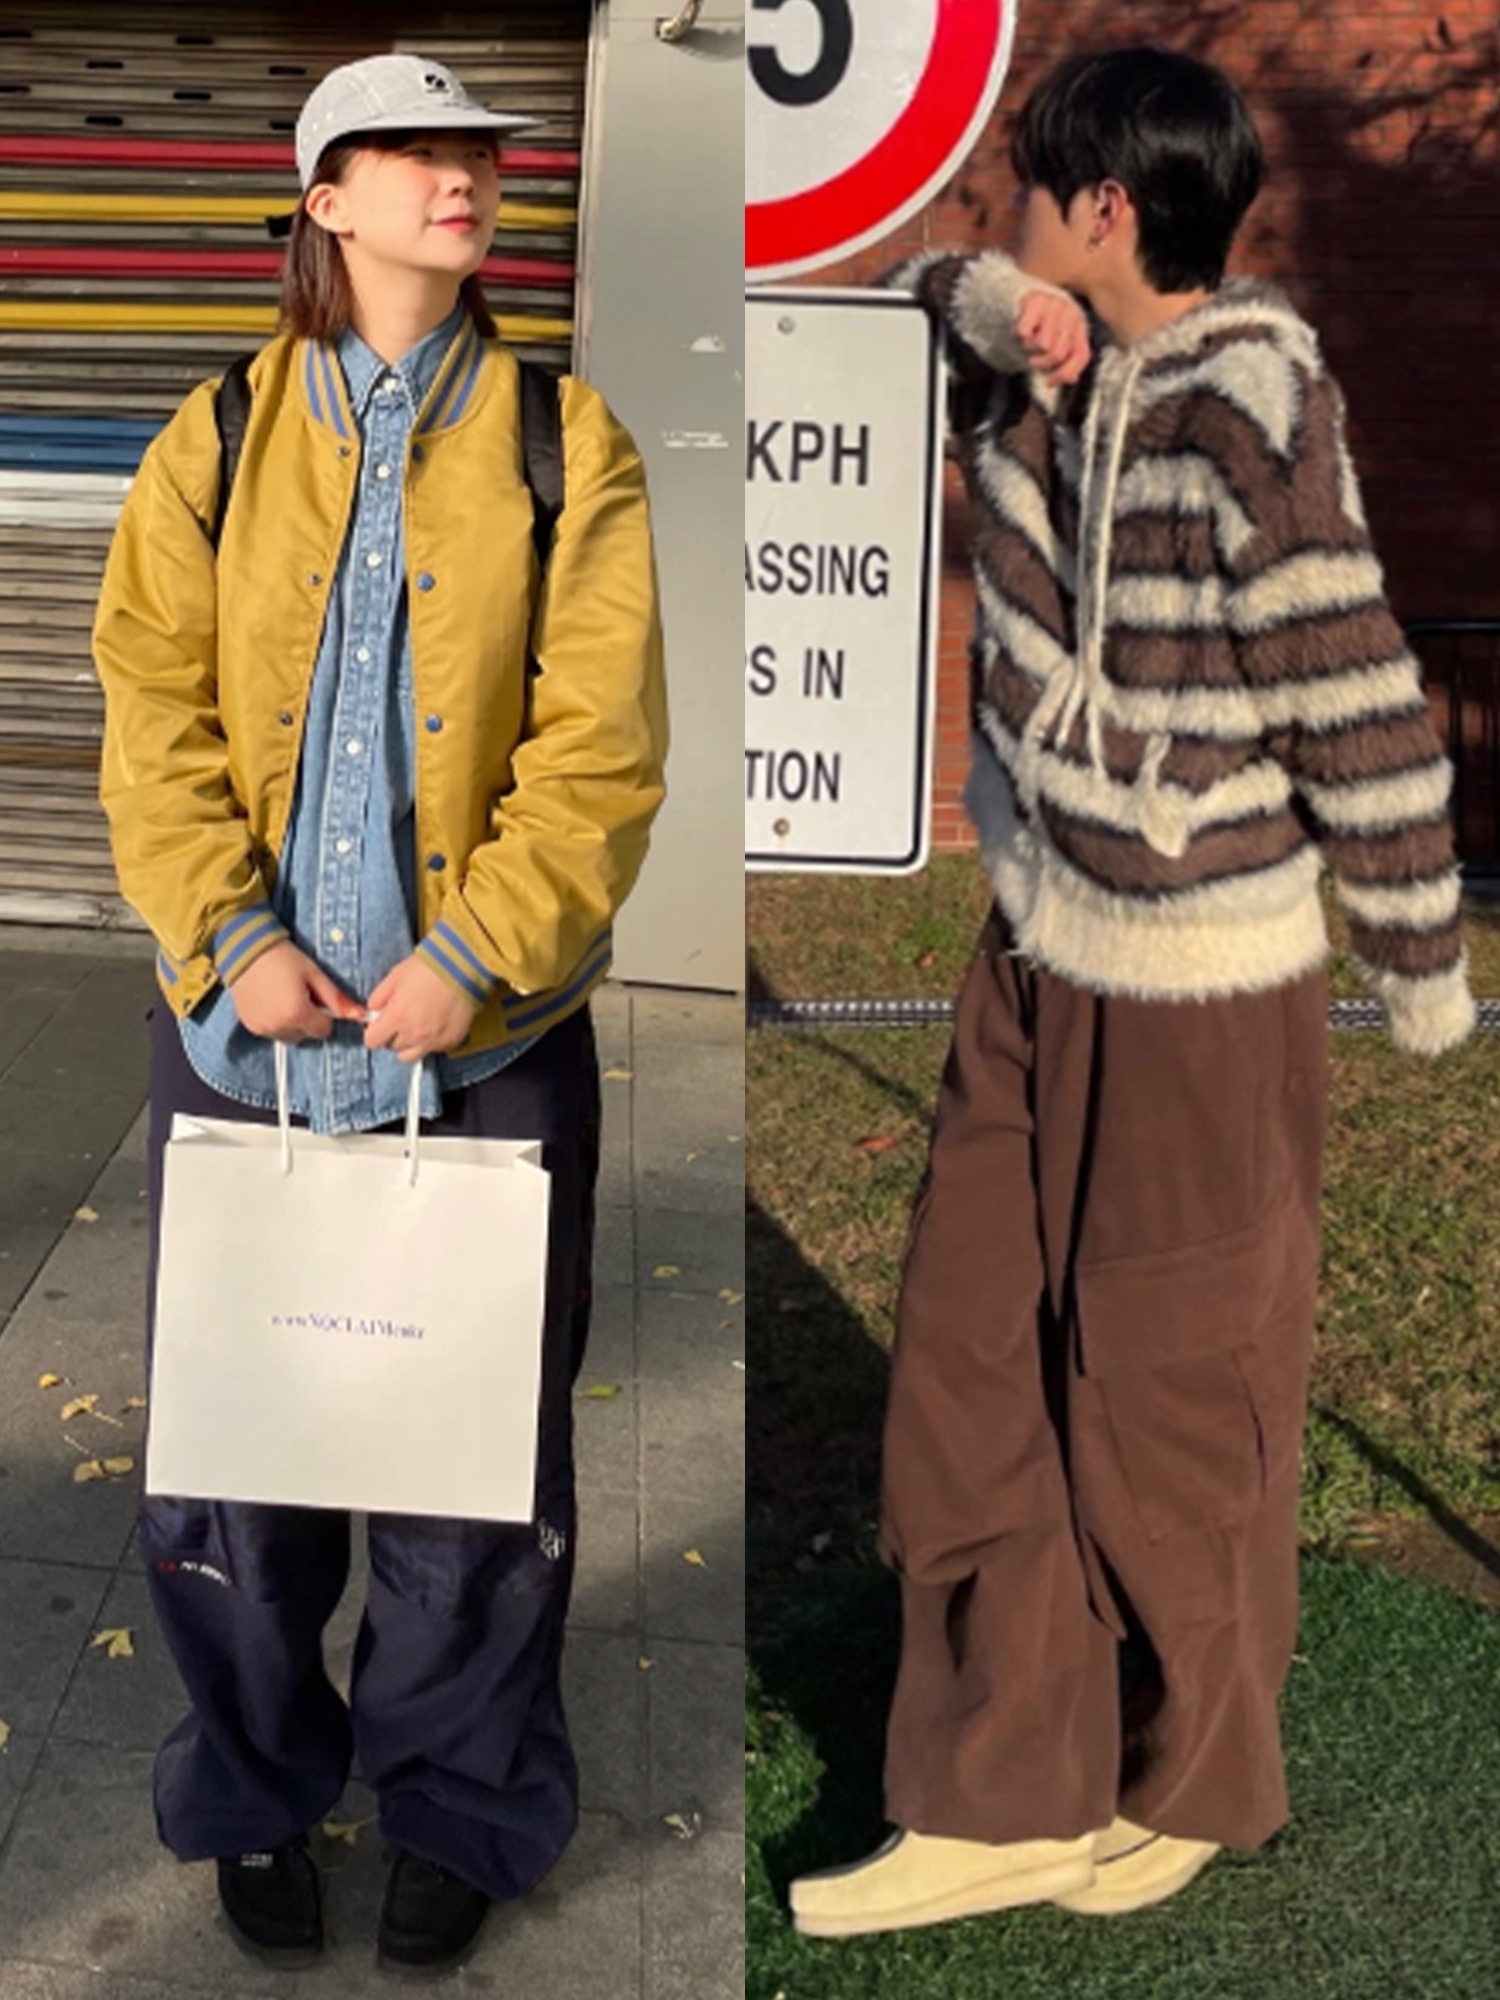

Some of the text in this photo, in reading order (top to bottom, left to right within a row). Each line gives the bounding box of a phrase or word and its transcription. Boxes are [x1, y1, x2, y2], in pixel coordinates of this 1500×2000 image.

[746, 420, 869, 487] KPH
[745, 645, 844, 699] S IN
[745, 750, 840, 802] TION
